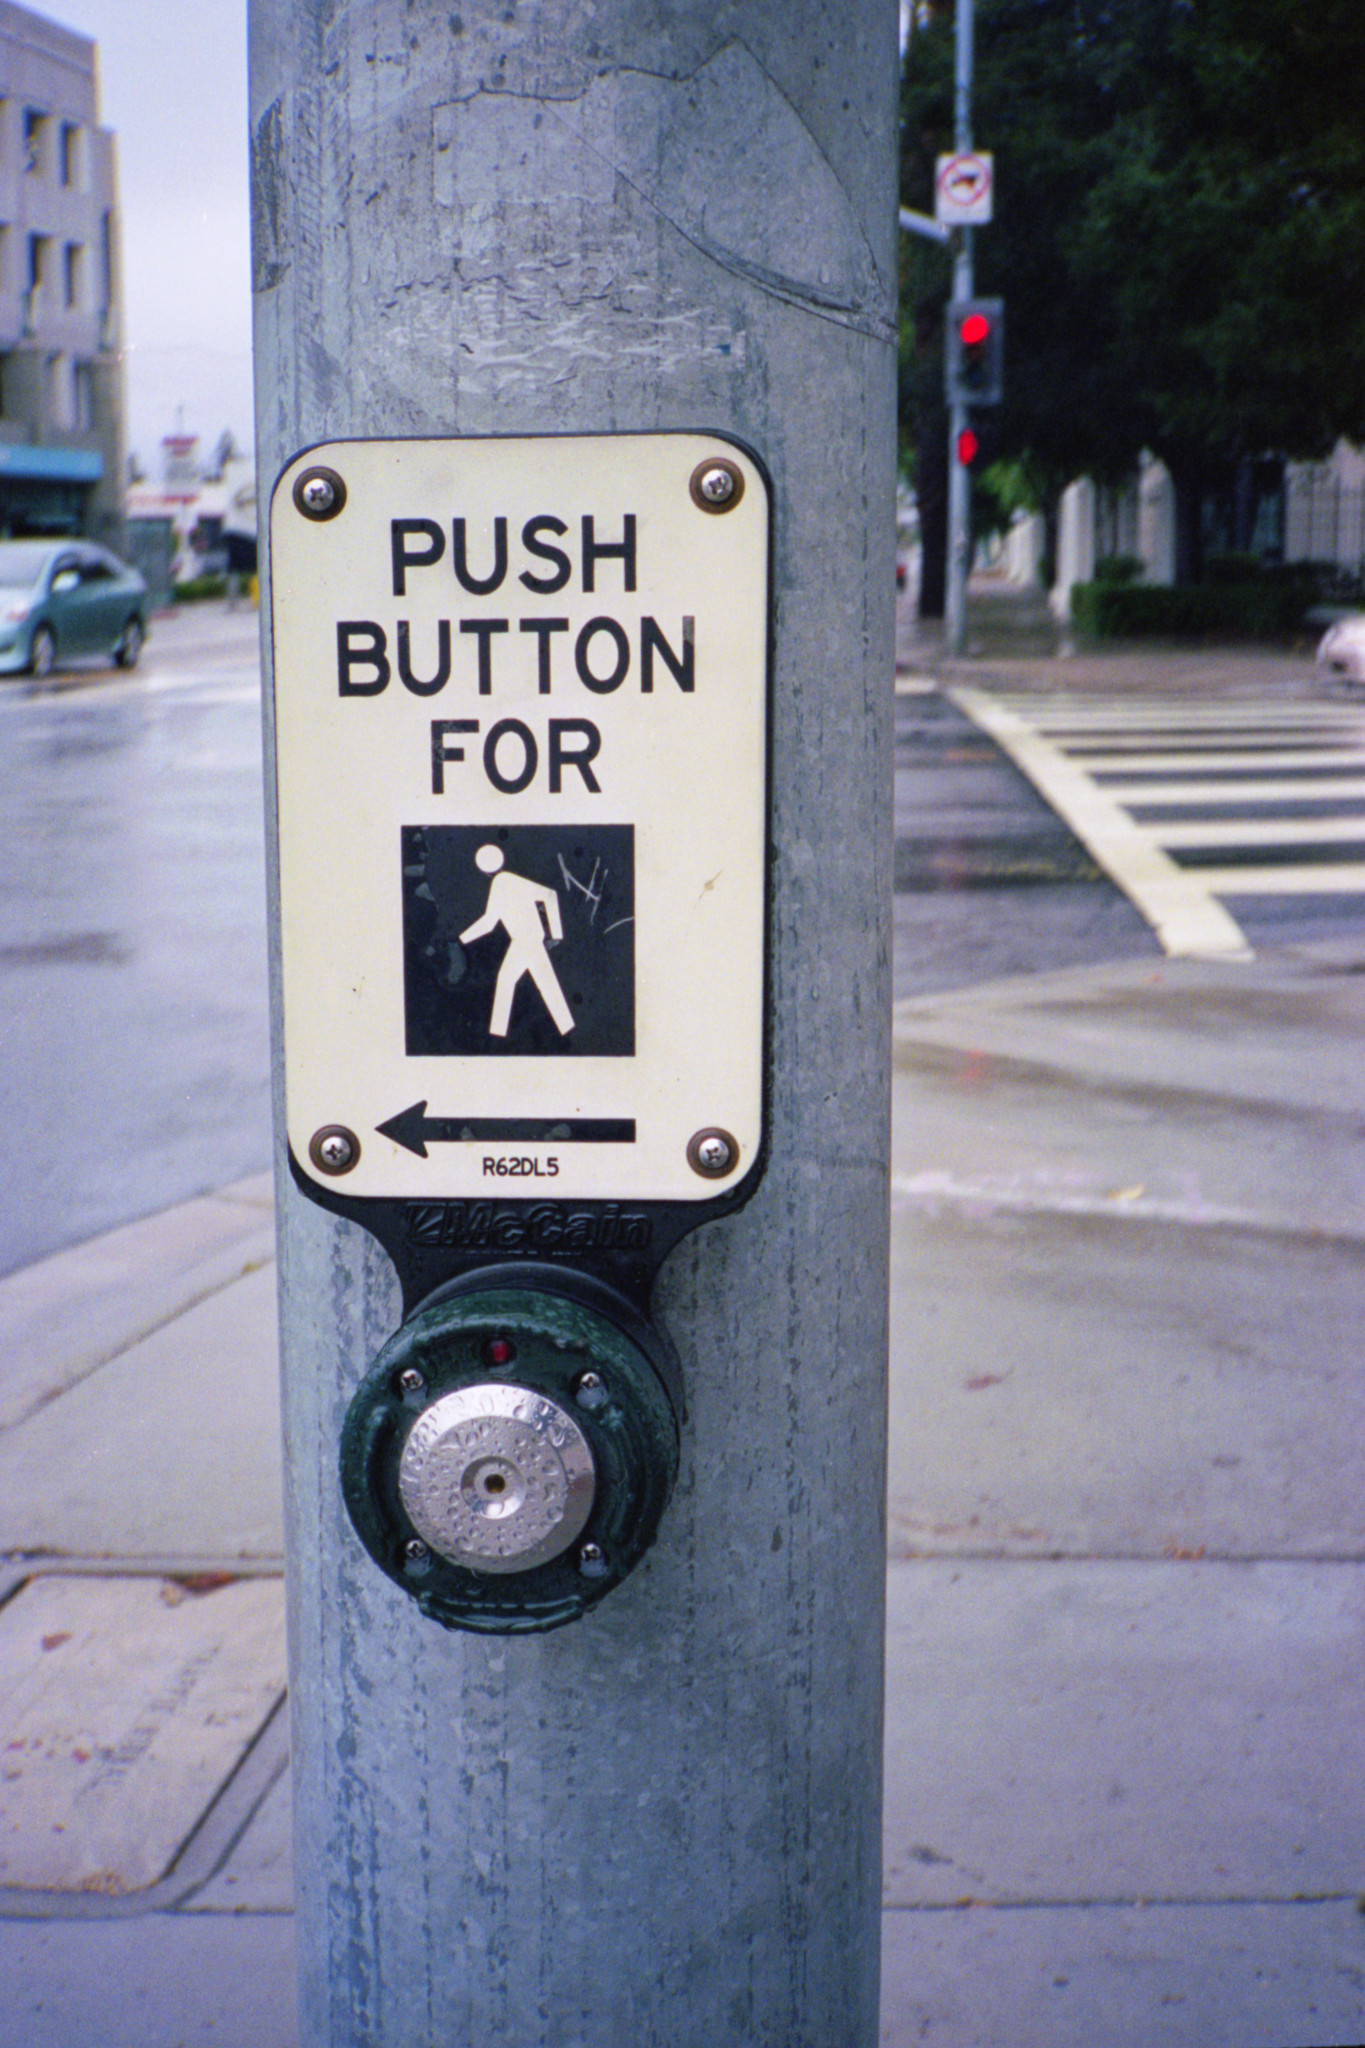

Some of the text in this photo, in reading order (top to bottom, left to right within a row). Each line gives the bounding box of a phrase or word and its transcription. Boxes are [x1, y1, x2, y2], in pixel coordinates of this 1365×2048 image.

[391, 514, 636, 597] PUSH
[336, 616, 695, 698] BUTTON
[430, 718, 602, 795] FOR
[482, 1157, 559, 1177] R62DL5
[442, 1201, 653, 1246] McCain
